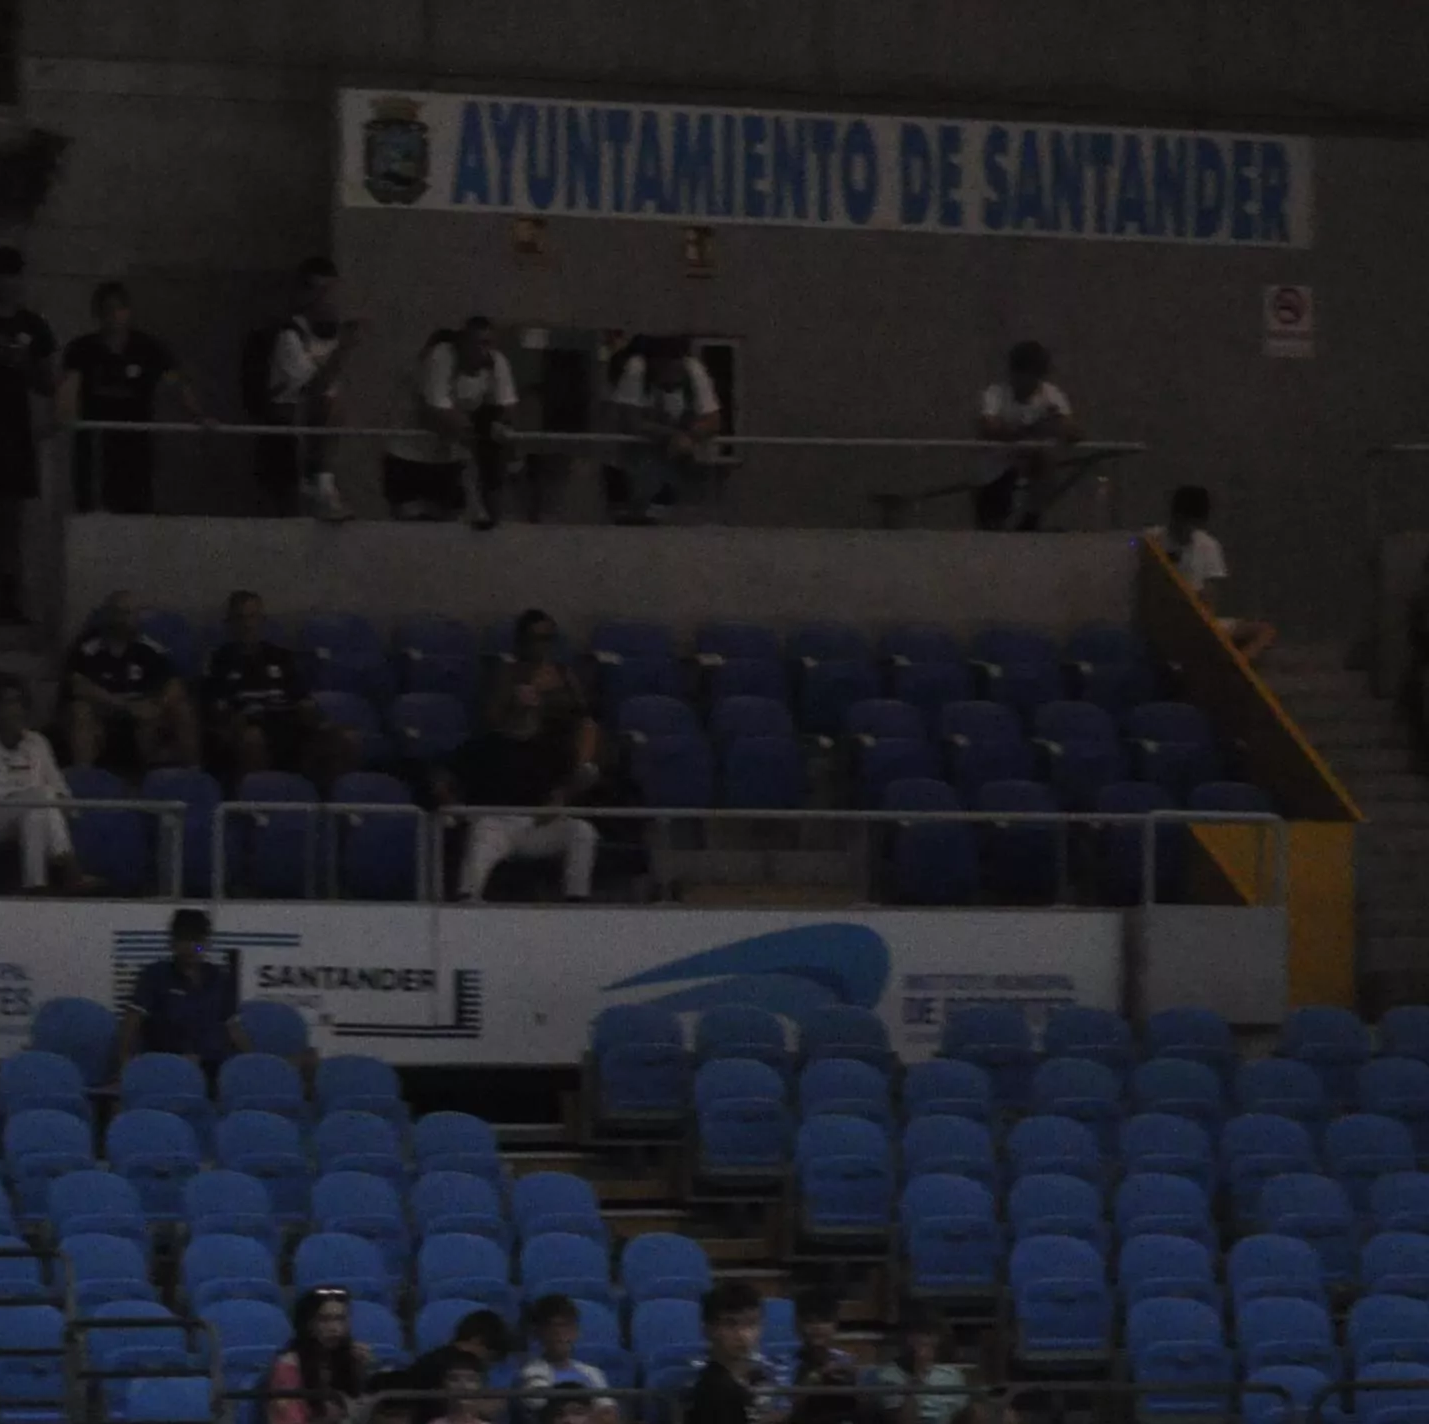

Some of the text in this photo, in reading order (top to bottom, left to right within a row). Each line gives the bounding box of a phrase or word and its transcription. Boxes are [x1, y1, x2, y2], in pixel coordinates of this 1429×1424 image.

[453, 99, 1292, 242] AYUNTAMIENTO DE SANTANDER
[257, 964, 436, 992] SANTANDER
